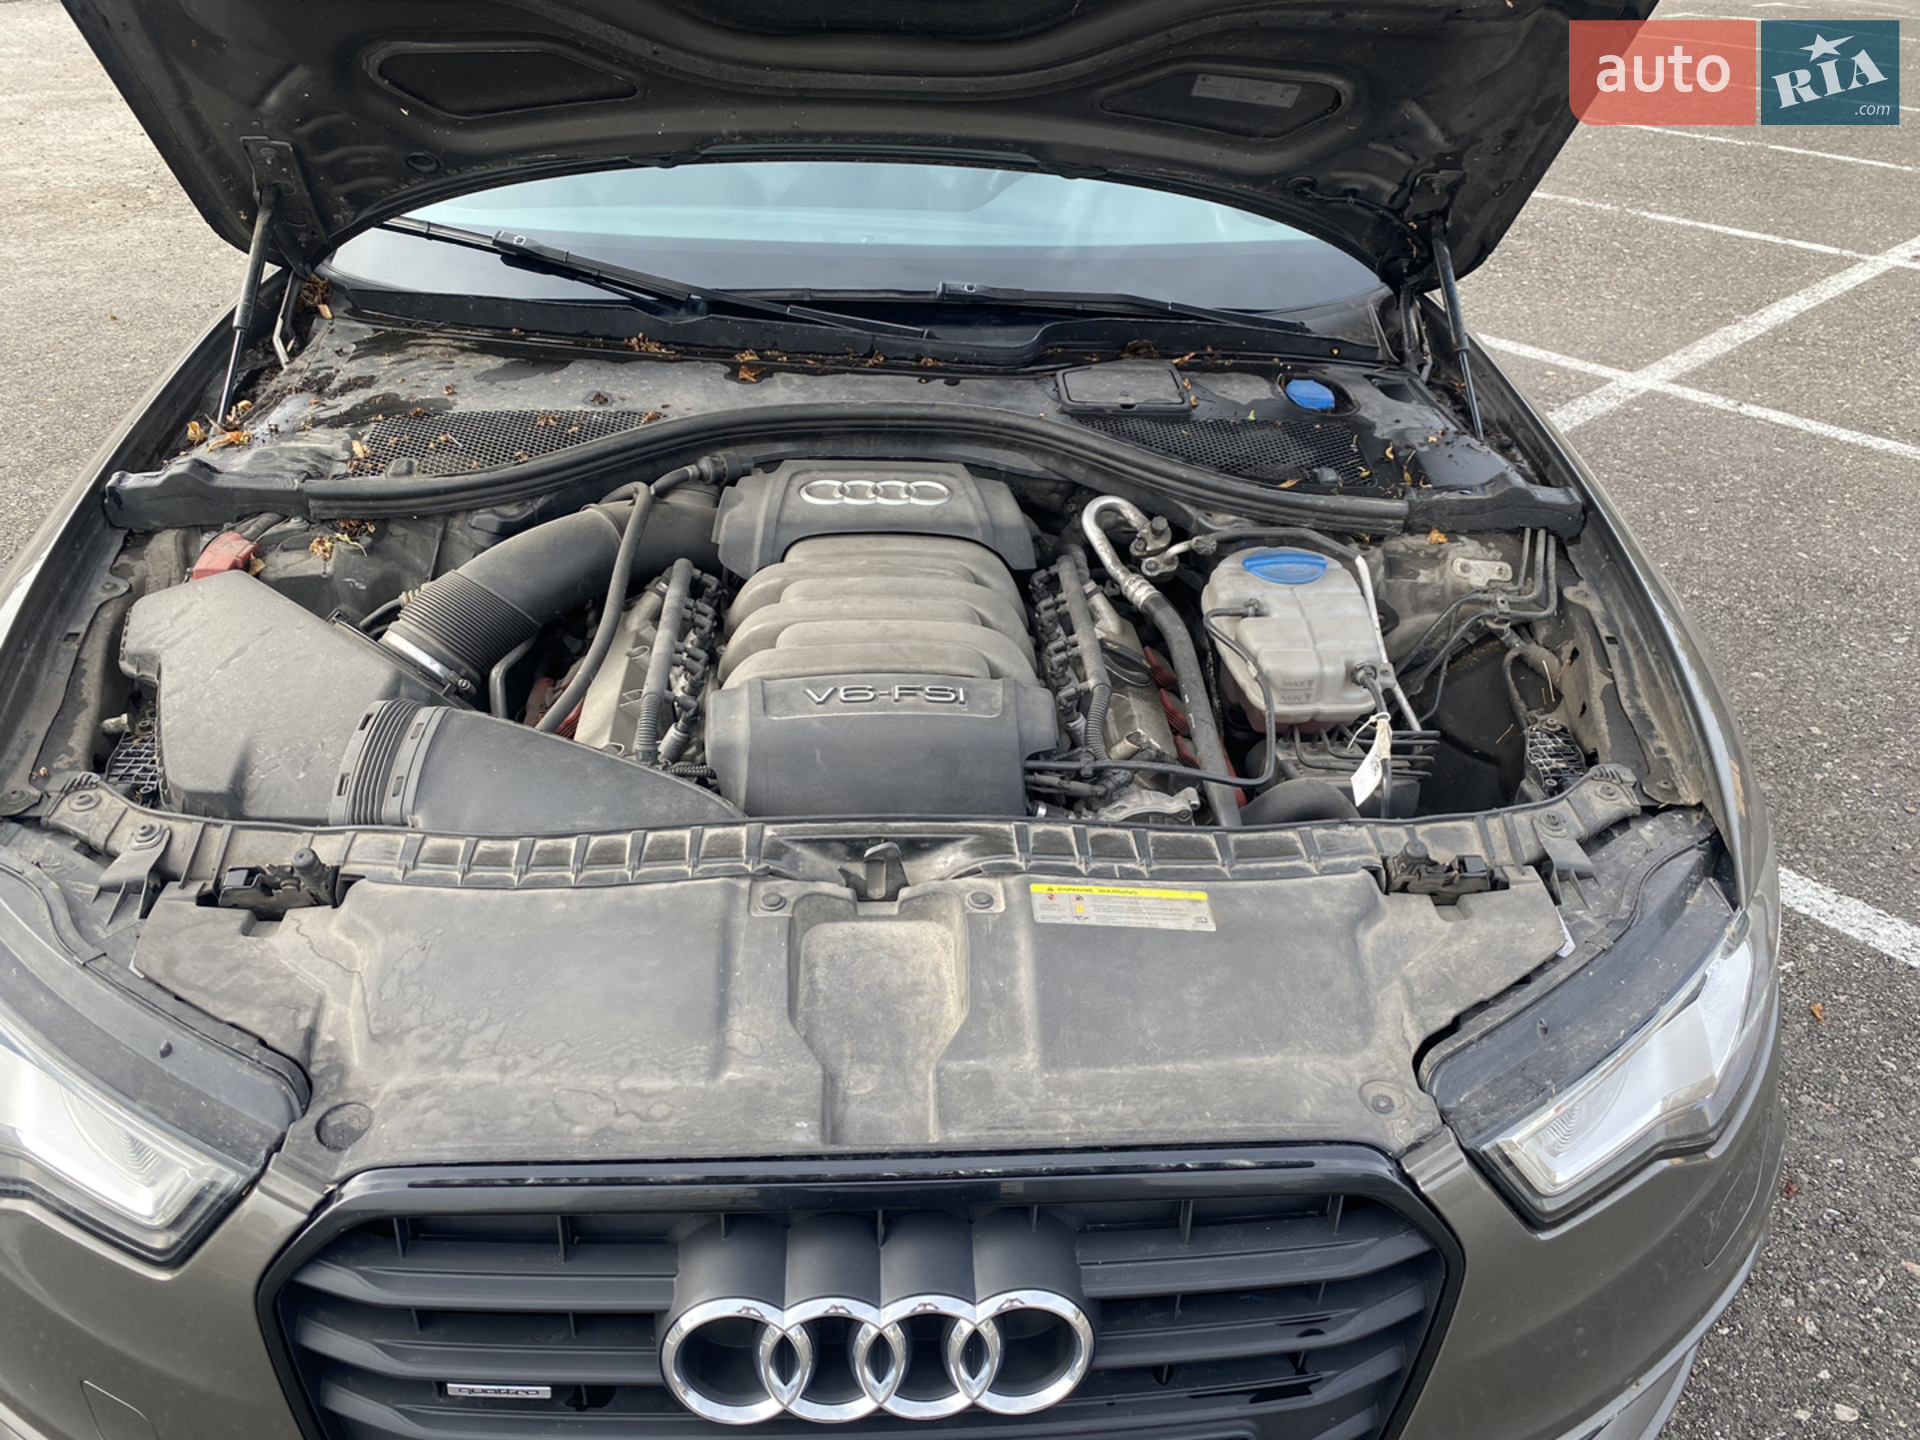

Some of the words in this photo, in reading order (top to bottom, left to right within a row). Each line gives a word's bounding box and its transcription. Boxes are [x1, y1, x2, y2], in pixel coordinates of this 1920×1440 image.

[1280, 680, 1306, 688] MAX
[803, 684, 968, 706] V6-FSI
[459, 1387, 539, 1396] quattro
